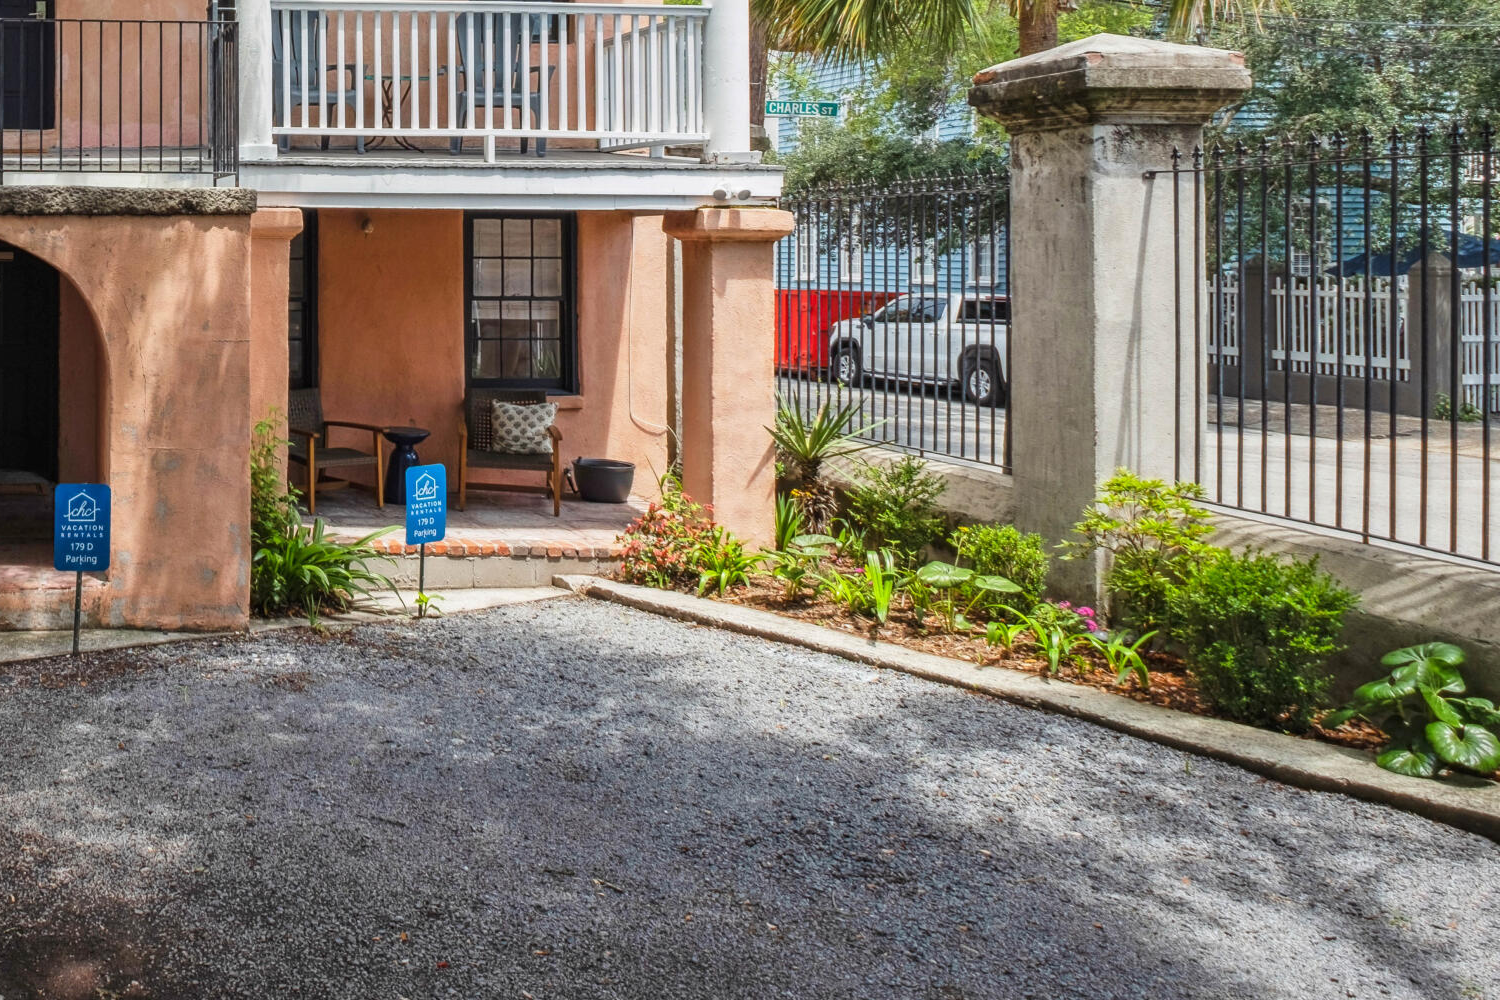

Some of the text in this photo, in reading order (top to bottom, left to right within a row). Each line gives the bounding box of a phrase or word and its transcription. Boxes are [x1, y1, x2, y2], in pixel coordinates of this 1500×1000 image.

[769, 102, 833, 115] CHARLES ST
[411, 500, 442, 509] VACATION
[411, 508, 441, 516] RENTALS
[418, 517, 435, 526] 179 D
[413, 529, 437, 537] Parking
[70, 542, 94, 551] 179 D
[65, 555, 97, 564] Parking
